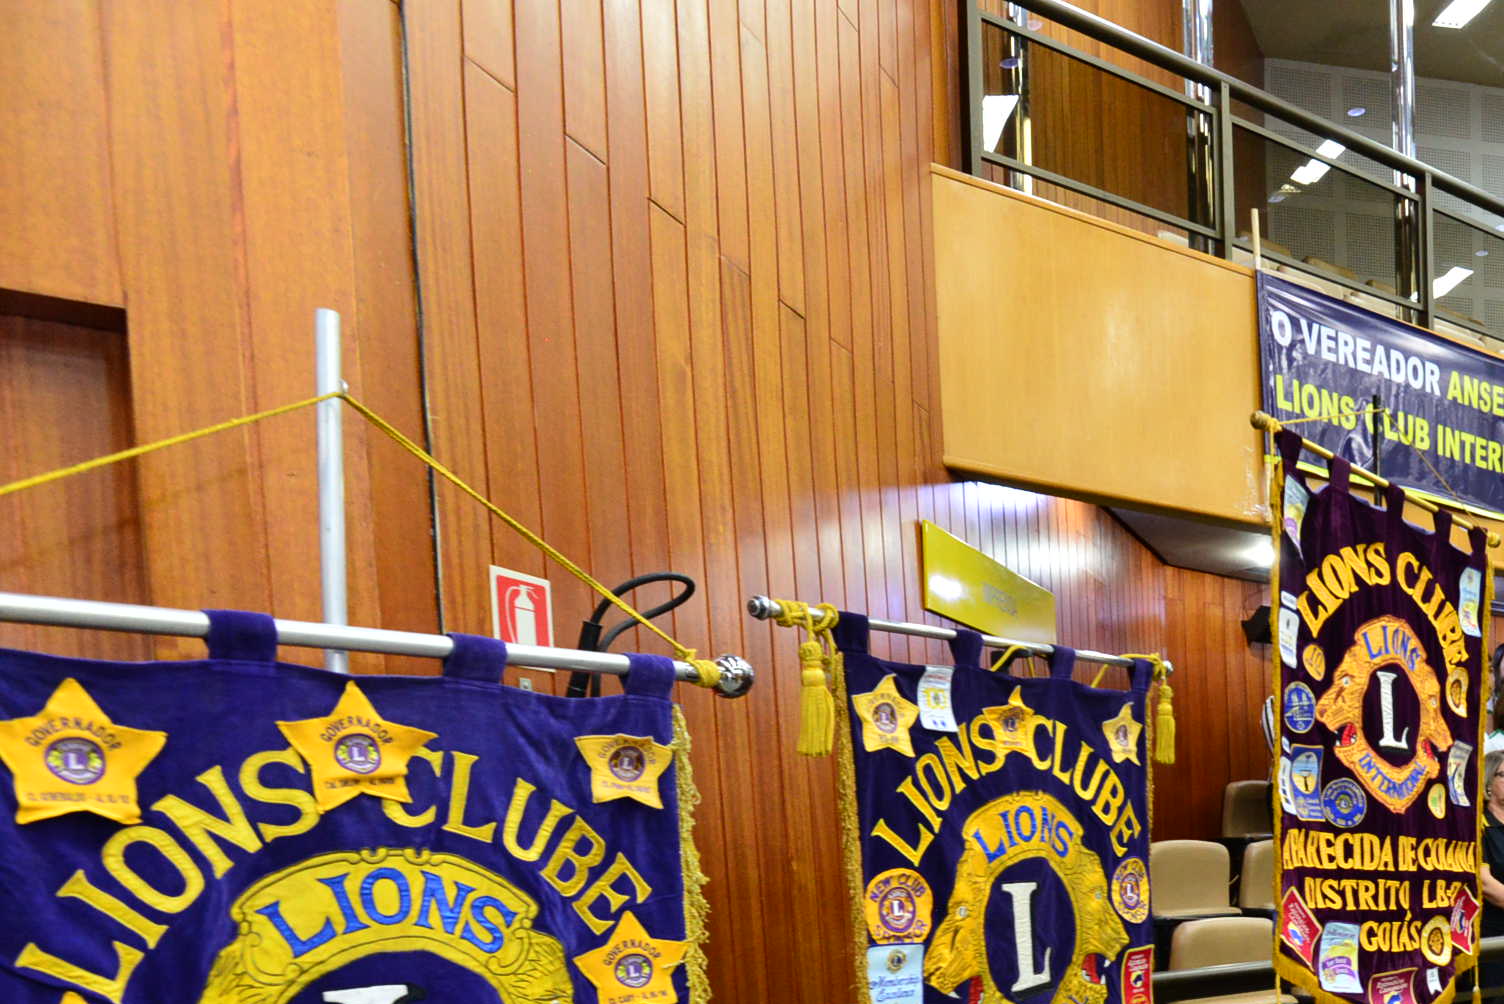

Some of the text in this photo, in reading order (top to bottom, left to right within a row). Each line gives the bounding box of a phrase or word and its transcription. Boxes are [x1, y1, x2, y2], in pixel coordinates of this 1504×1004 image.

[1271, 310, 1292, 346] O
[1300, 320, 1441, 395] VEREADOR
[1273, 374, 1357, 431] LIONS
[1365, 402, 1431, 450] CLUB
[1297, 542, 1392, 639] LIONS
[1360, 624, 1421, 672] LIONS
[1375, 671, 1410, 750] L
[871, 713, 1141, 867] LIONS CLUBE
[380, 748, 652, 935] CLUBE
[972, 805, 1075, 864] LIONS
[1398, 835, 1417, 872] DE
[256, 867, 518, 959] LIONS
[1304, 877, 1410, 911] DISTRITO
[1360, 910, 1422, 953] GOIÁS
[1001, 881, 1052, 997] L
